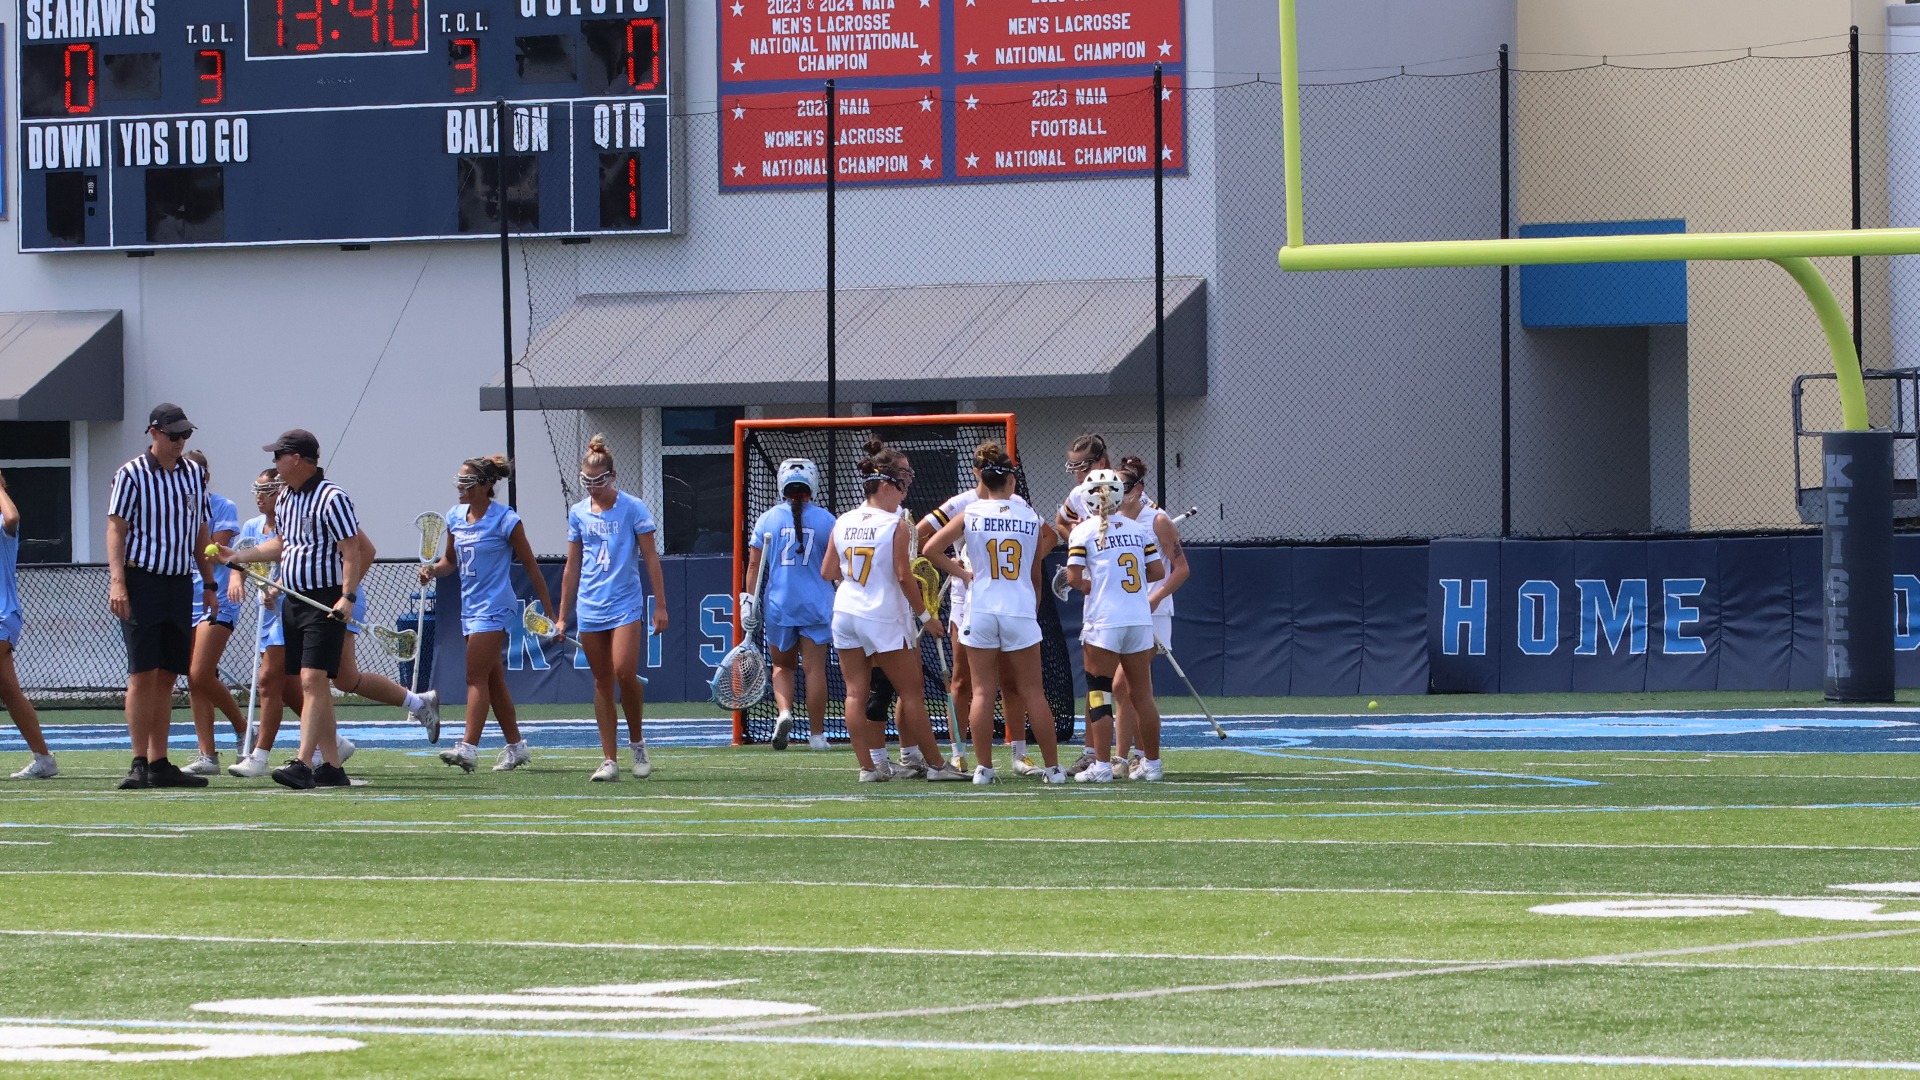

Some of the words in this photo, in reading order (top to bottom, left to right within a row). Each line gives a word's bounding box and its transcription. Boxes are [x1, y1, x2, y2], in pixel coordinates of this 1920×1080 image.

[27, 0, 156, 40] SEAHAWKS
[772, 17, 812, 35] MEN'S
[817, 13, 891, 33] LACROSSE
[1008, 17, 1049, 35] MEN'S
[1055, 12, 1131, 33] LACROSSE
[750, 36, 818, 55] NATIONAL
[827, 32, 919, 52] INVITATIONAL
[995, 45, 1065, 65] NATIONAL
[1074, 41, 1146, 62] CHAMPION
[454, 39, 477, 93] 3
[798, 53, 868, 72] CHAMPION
[200, 50, 223, 104] 3
[839, 98, 870, 115] NAIA
[1032, 88, 1067, 107] 2023
[1075, 86, 1108, 106] NAIA
[513, 106, 549, 152] ON
[594, 102, 645, 150] QTR
[764, 130, 825, 148] WOMEN'S
[834, 127, 904, 146] ACROSSE
[1031, 118, 1107, 138] FOOTBALL
[28, 123, 101, 170] DOWN
[120, 121, 169, 167] YDS
[176, 119, 207, 165] TO
[215, 118, 249, 163] GO
[762, 158, 828, 177] NATIONAL
[838, 155, 908, 175] CHAMPION
[995, 150, 1066, 169] NATIONAL
[1074, 145, 1147, 165] CHAMPION
[843, 527, 878, 541] KROHN
[984, 517, 1037, 536] BERKELEY
[596, 540, 611, 572] 4
[780, 527, 815, 567] 27
[985, 538, 1023, 581] 13
[843, 546, 877, 588] 17
[1117, 552, 1142, 594] 3
[1438, 578, 1708, 656] HOME
